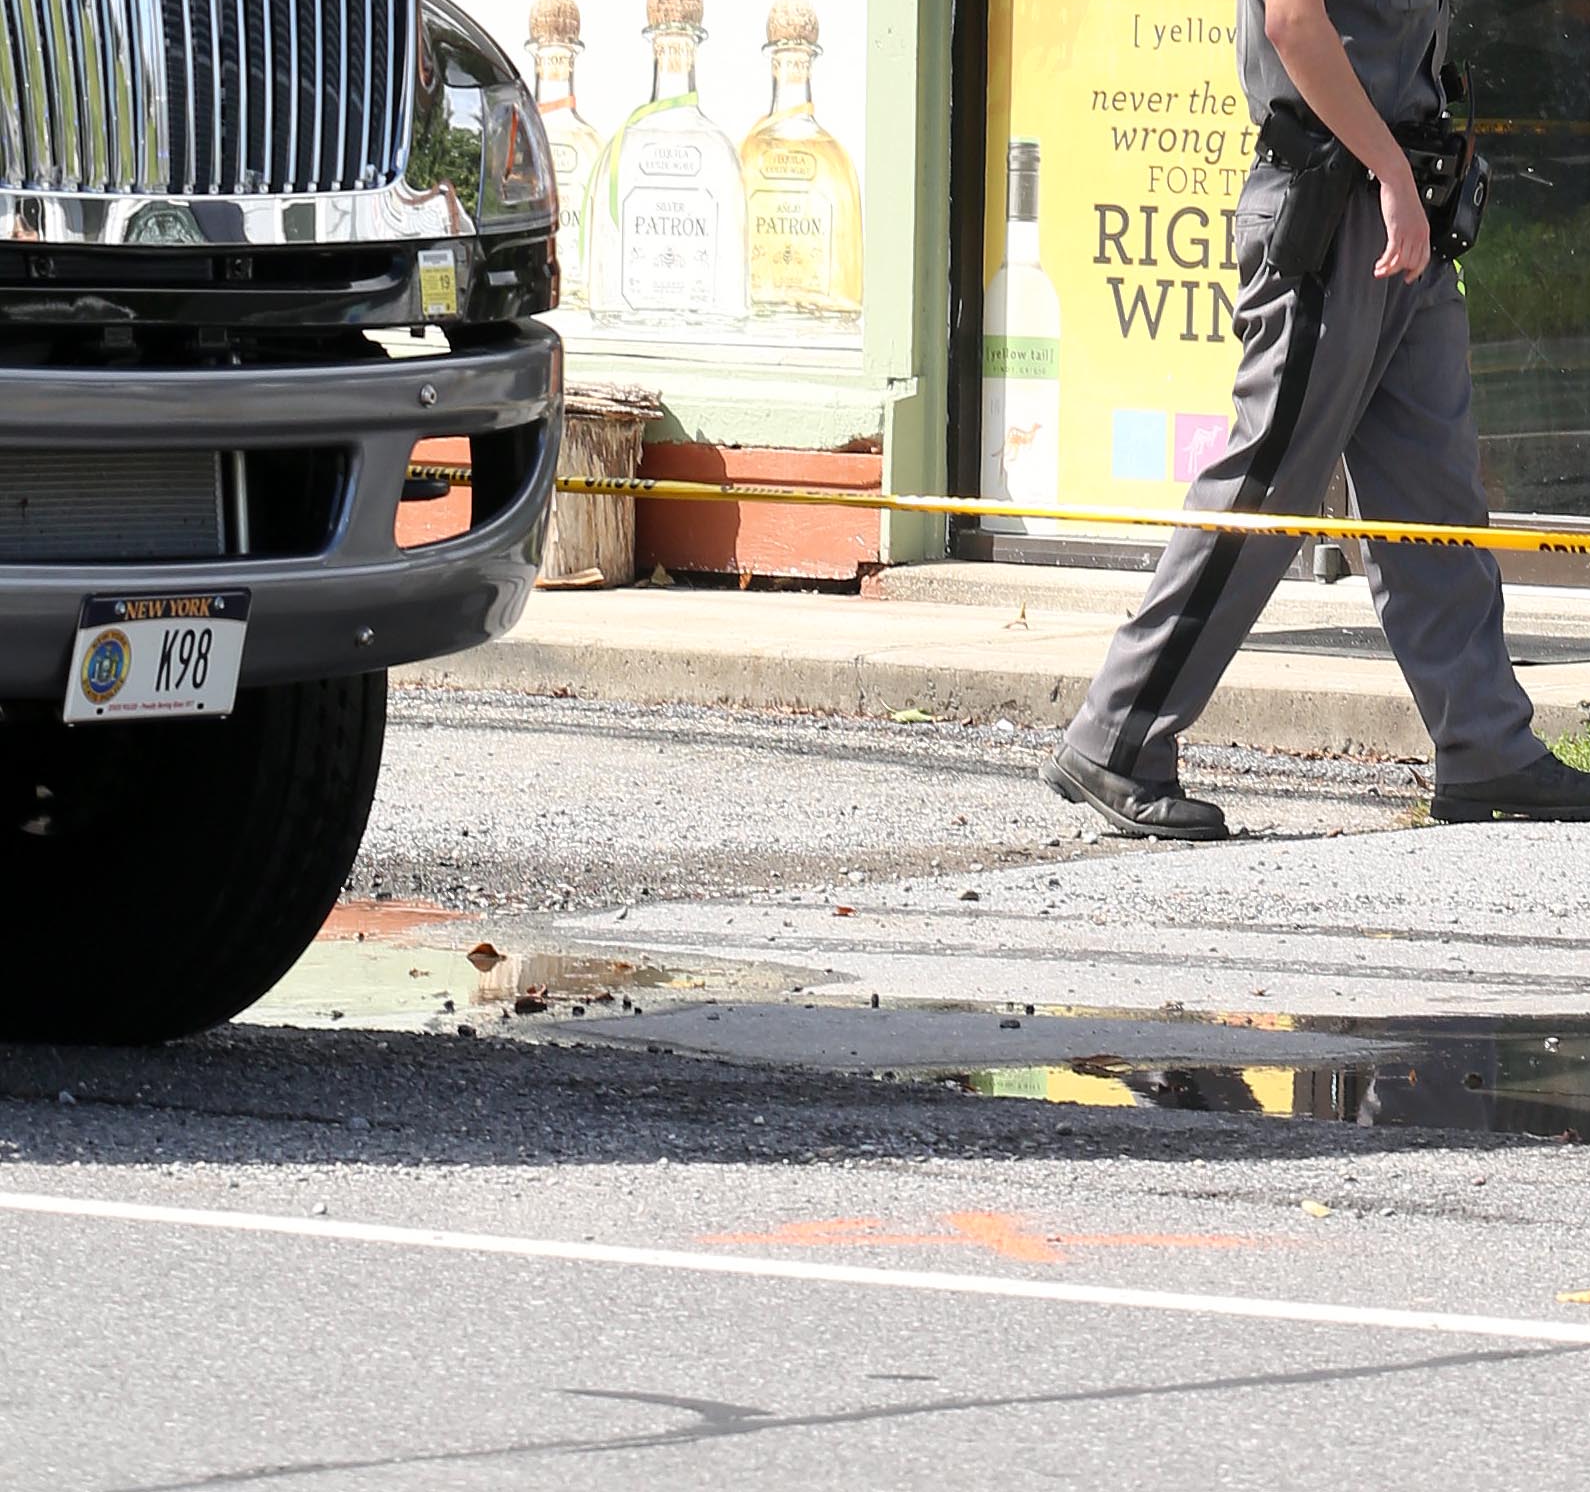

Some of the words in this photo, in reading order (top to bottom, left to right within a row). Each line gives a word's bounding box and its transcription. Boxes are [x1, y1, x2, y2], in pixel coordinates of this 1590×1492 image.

[1091, 89, 1179, 113] never
[1189, 81, 1236, 116] the
[1111, 125, 1226, 165] wrong
[1148, 165, 1209, 195] FOR
[1106, 276, 1235, 343] WIN
[125, 599, 167, 620] NEW
[169, 597, 213, 617] YORK
[155, 628, 213, 692] K98
